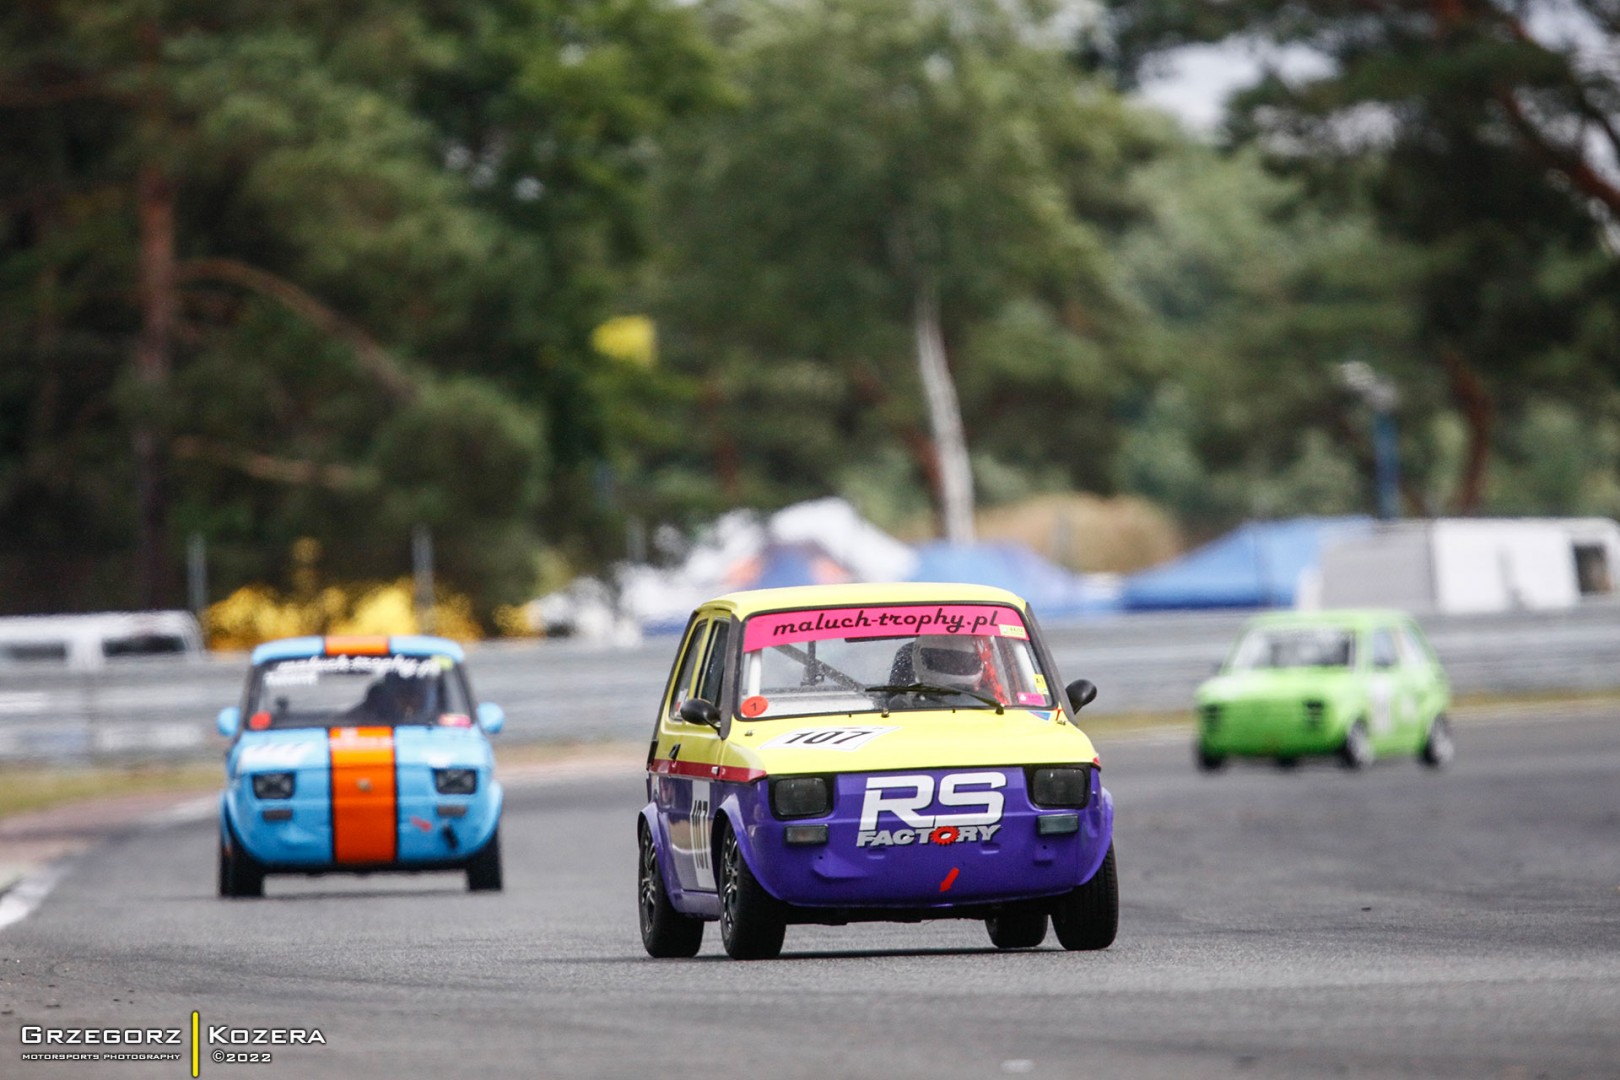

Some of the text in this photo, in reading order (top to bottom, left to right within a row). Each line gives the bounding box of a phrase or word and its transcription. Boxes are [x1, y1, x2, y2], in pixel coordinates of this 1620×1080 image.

[773, 608, 998, 636] maluch-trophy.pl
[750, 702, 757, 711] 1
[784, 731, 874, 745] 107
[859, 772, 1007, 831] RS
[856, 825, 1001, 847] FACTORY
